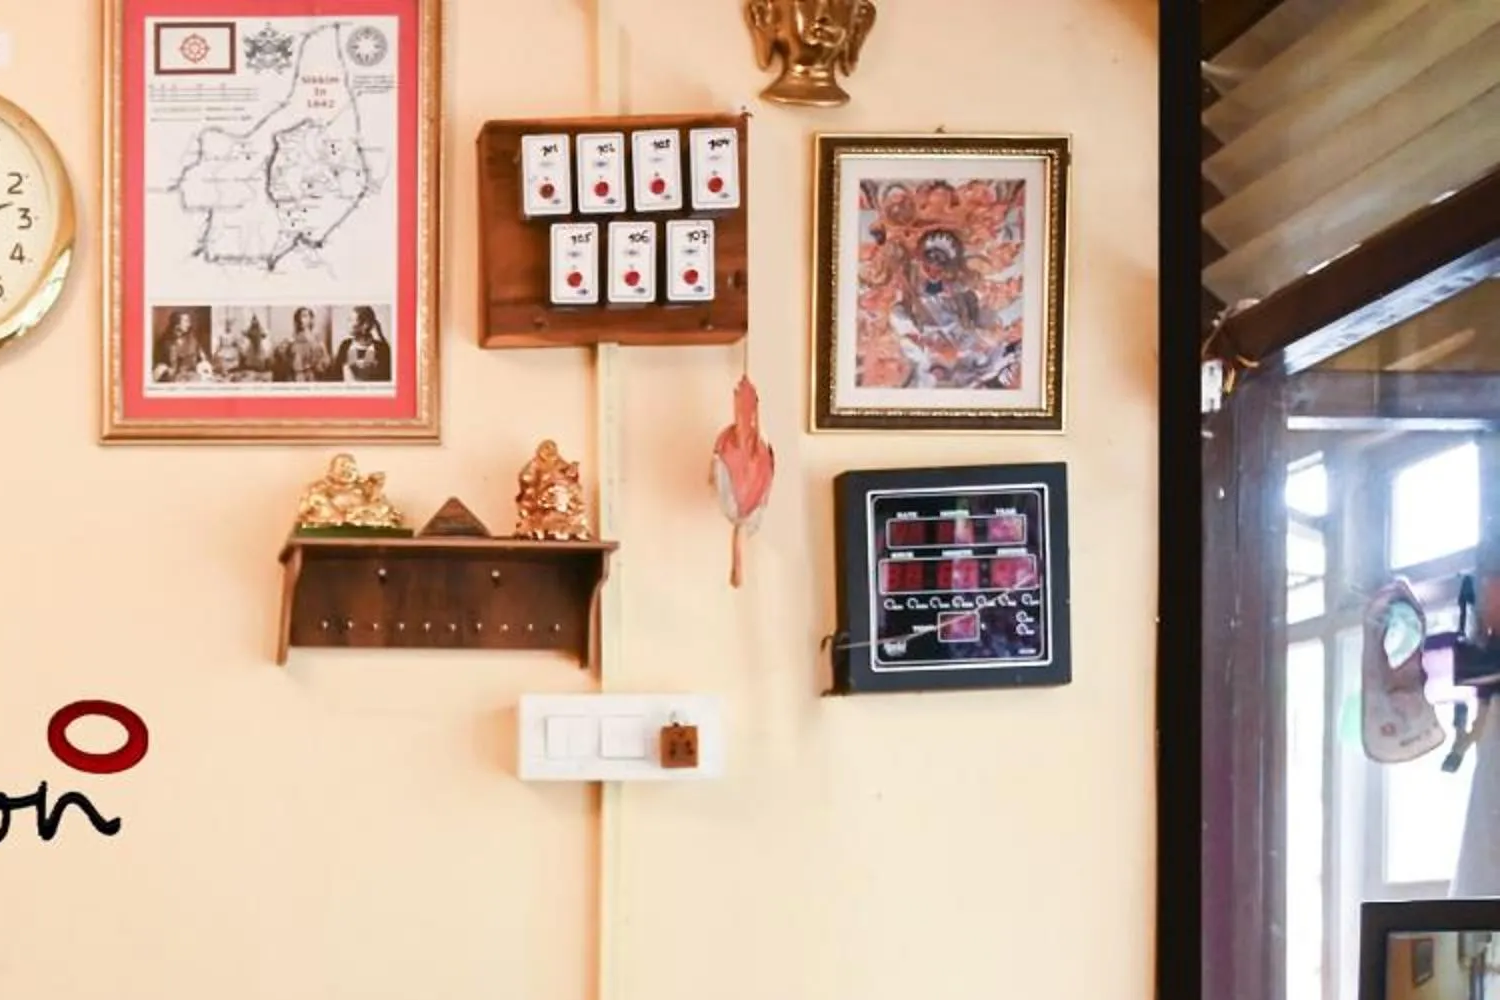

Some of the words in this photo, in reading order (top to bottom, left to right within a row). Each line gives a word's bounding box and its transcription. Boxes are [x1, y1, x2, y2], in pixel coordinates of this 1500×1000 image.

[7, 172, 23, 194] 2
[17, 208, 32, 229] 3
[9, 243, 25, 263] 4
